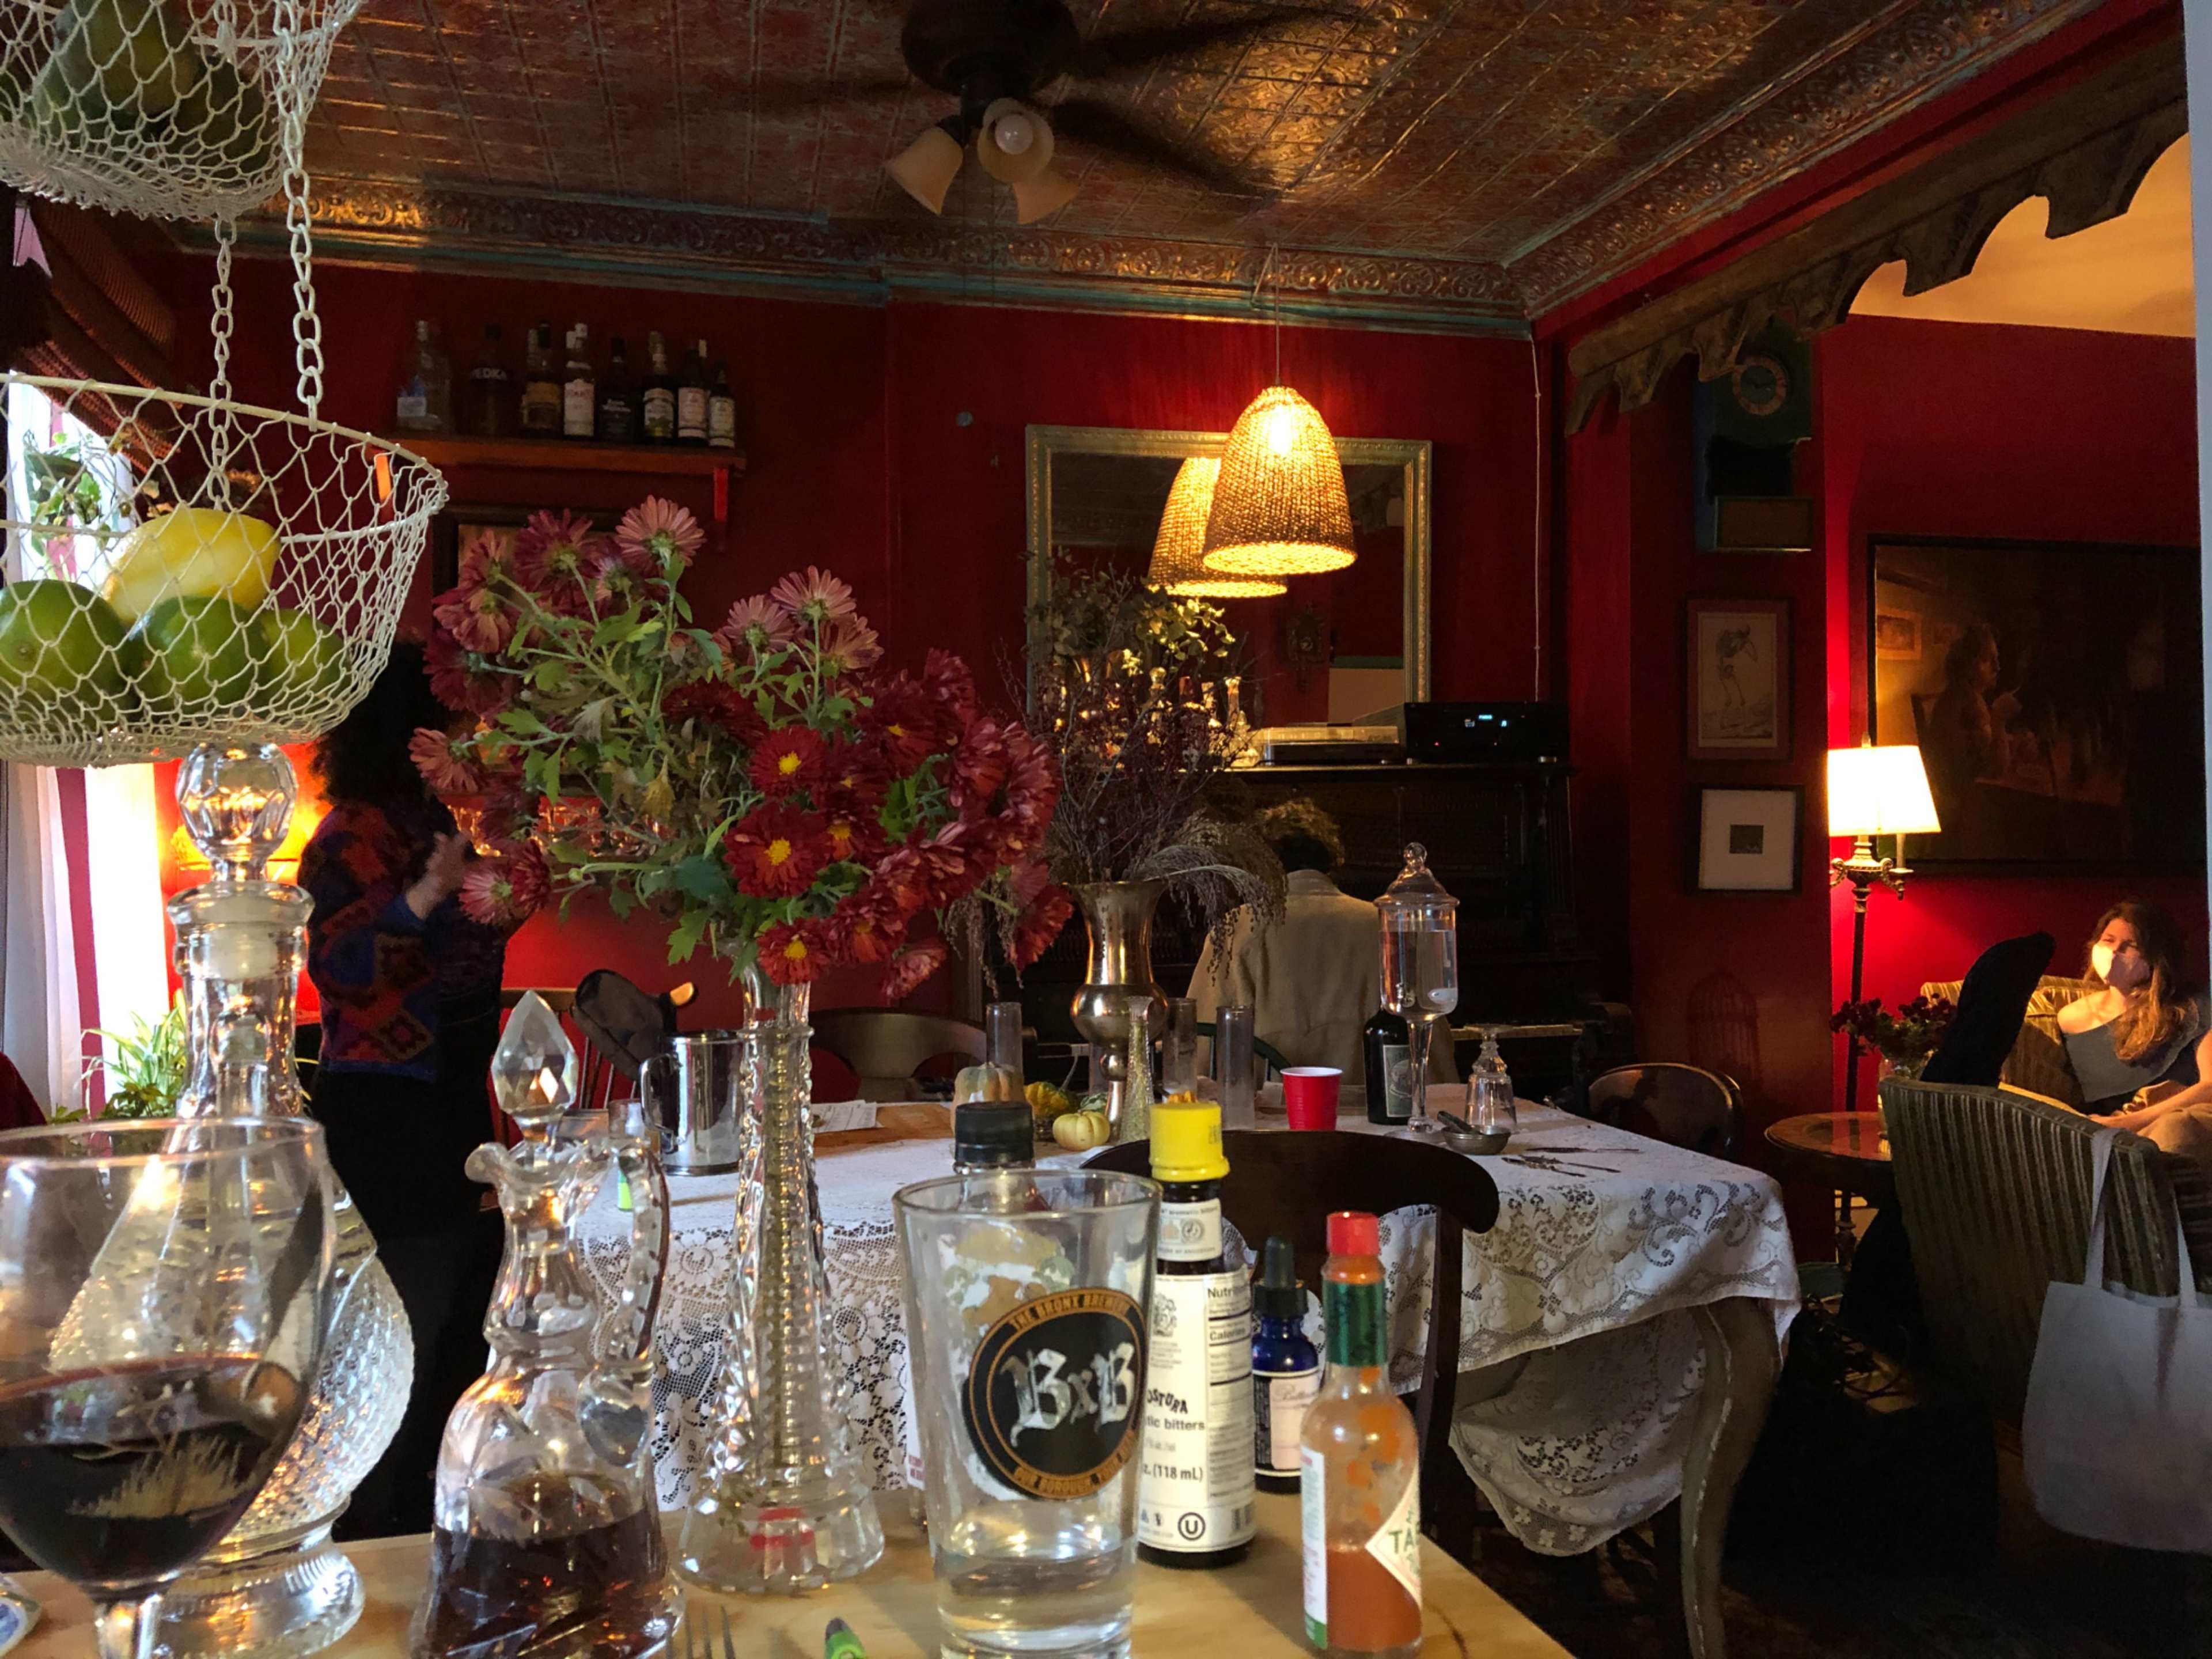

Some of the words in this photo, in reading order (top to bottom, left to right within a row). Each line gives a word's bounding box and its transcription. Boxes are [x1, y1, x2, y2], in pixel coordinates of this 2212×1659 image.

[1164, 1418, 1205, 1431] bitters
[1153, 1463, 1177, 1480] (118
[1180, 1467, 1203, 1483] mL)
